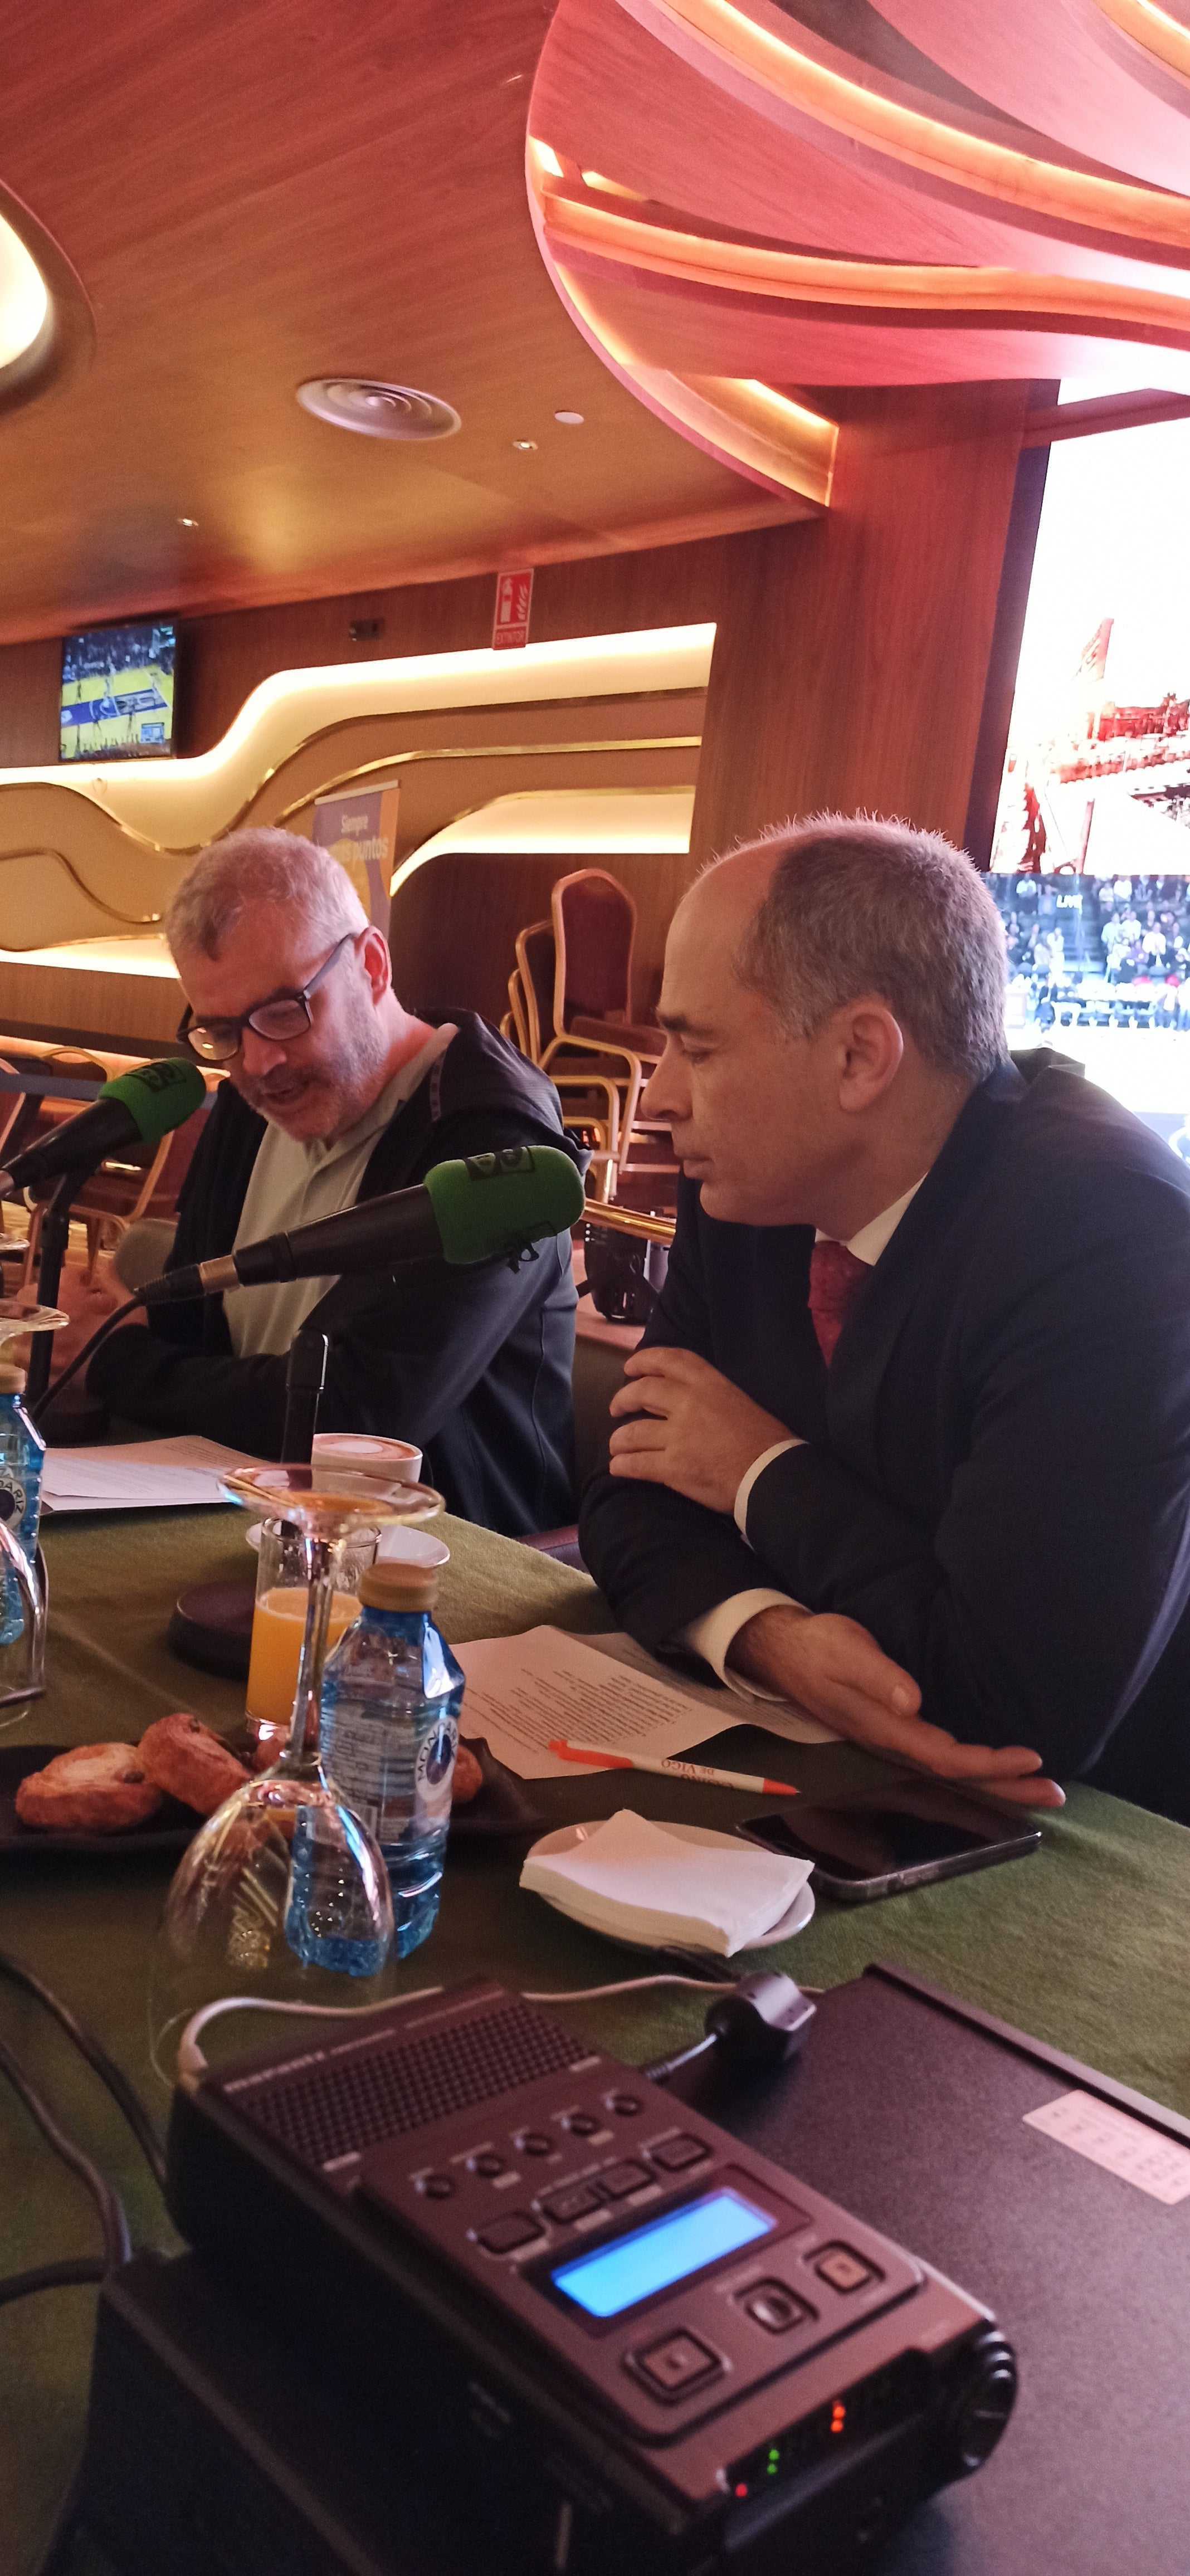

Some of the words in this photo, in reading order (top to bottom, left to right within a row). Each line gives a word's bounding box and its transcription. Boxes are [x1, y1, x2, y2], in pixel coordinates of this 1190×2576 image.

[341, 814, 369, 836] Siempre
[1056, 894, 1083, 909] LIVE
[661, 1759, 696, 1774] VIGO
